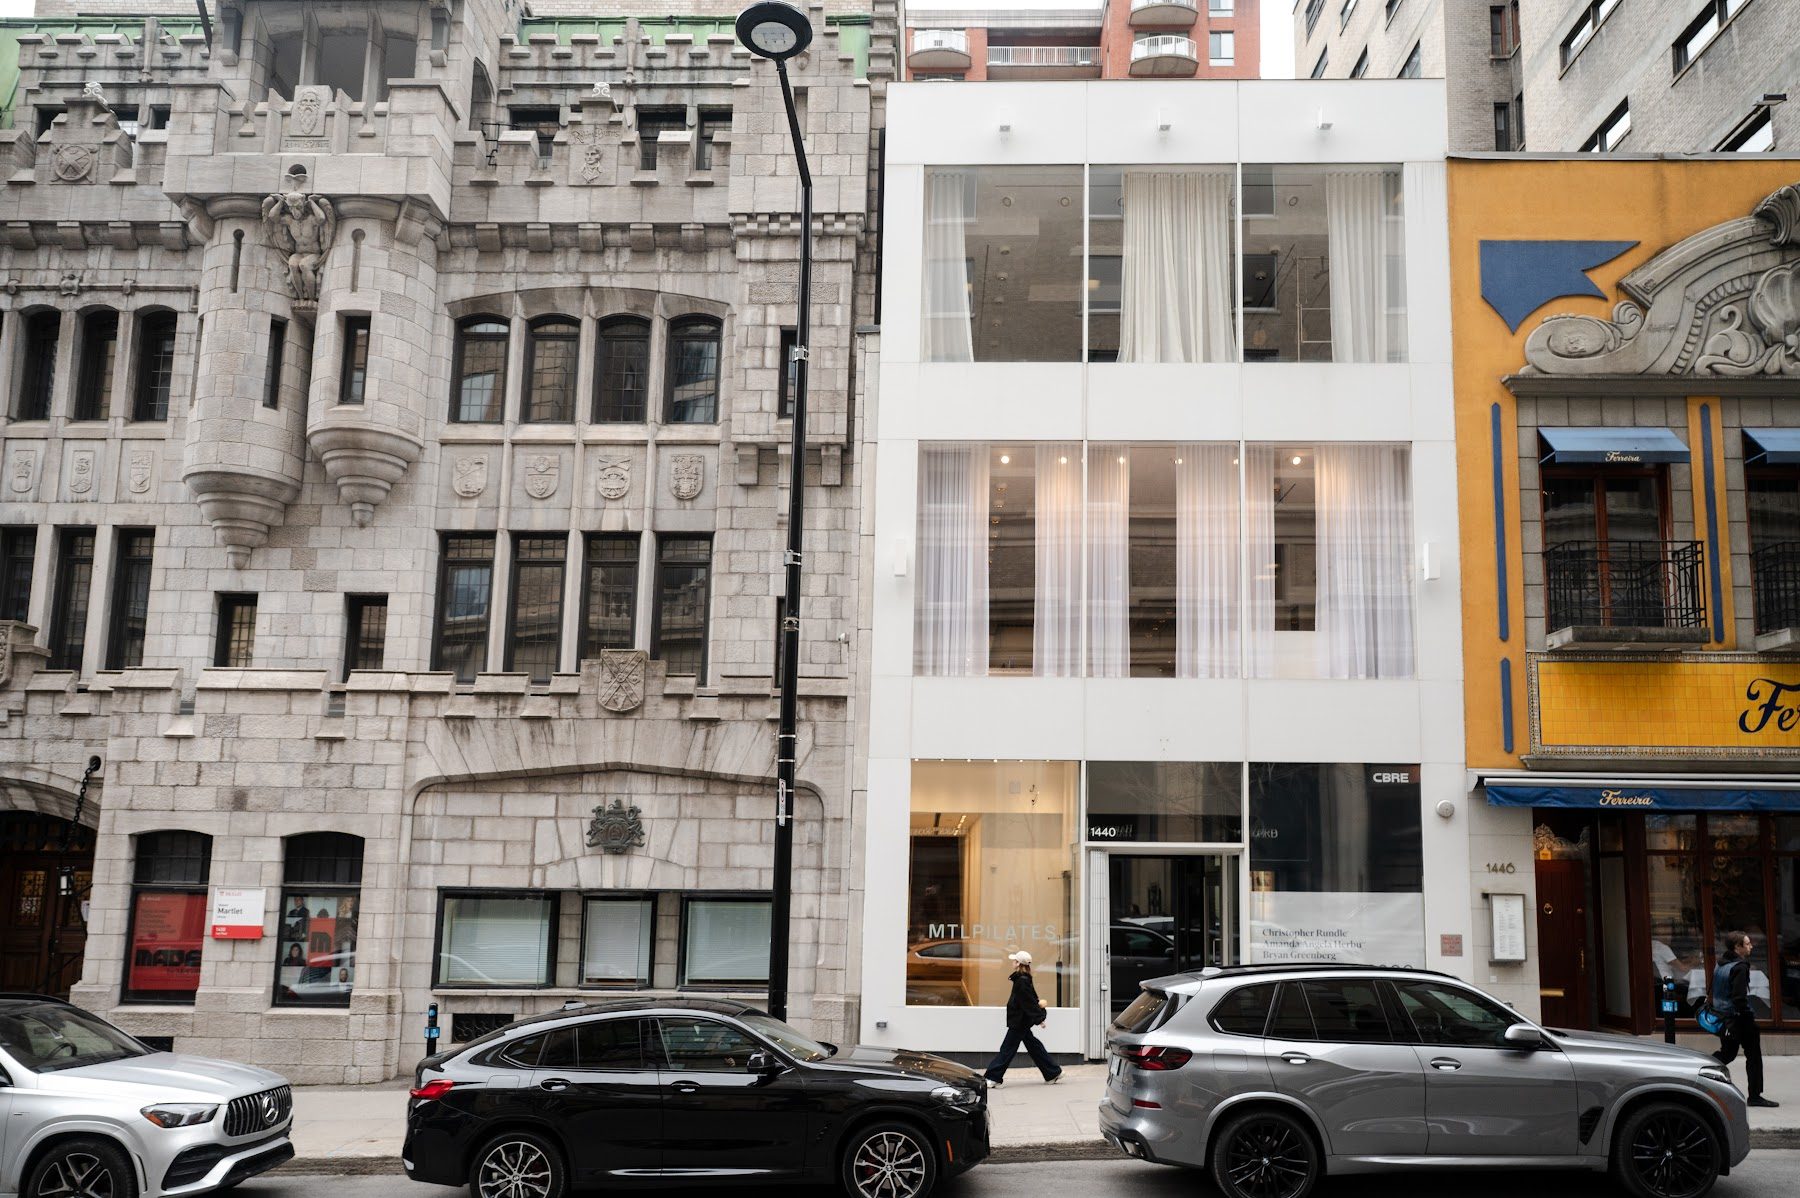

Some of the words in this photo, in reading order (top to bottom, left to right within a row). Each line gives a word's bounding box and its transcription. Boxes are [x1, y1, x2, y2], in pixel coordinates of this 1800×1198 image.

[1605, 451, 1641, 462] Ferreira
[1738, 678, 1800, 733] Fe
[1372, 772, 1410, 783] CBRE
[1600, 789, 1654, 806] Ferreira
[1090, 827, 1117, 838] 1440
[1486, 862, 1516, 874] 1446
[217, 907, 243, 915] Martlet
[1262, 928, 1314, 939] Christopher
[1316, 928, 1348, 938] Rundle
[1263, 939, 1300, 949] Amanda
[1263, 950, 1289, 960] Bryan
[1290, 950, 1337, 961] Greenberg
